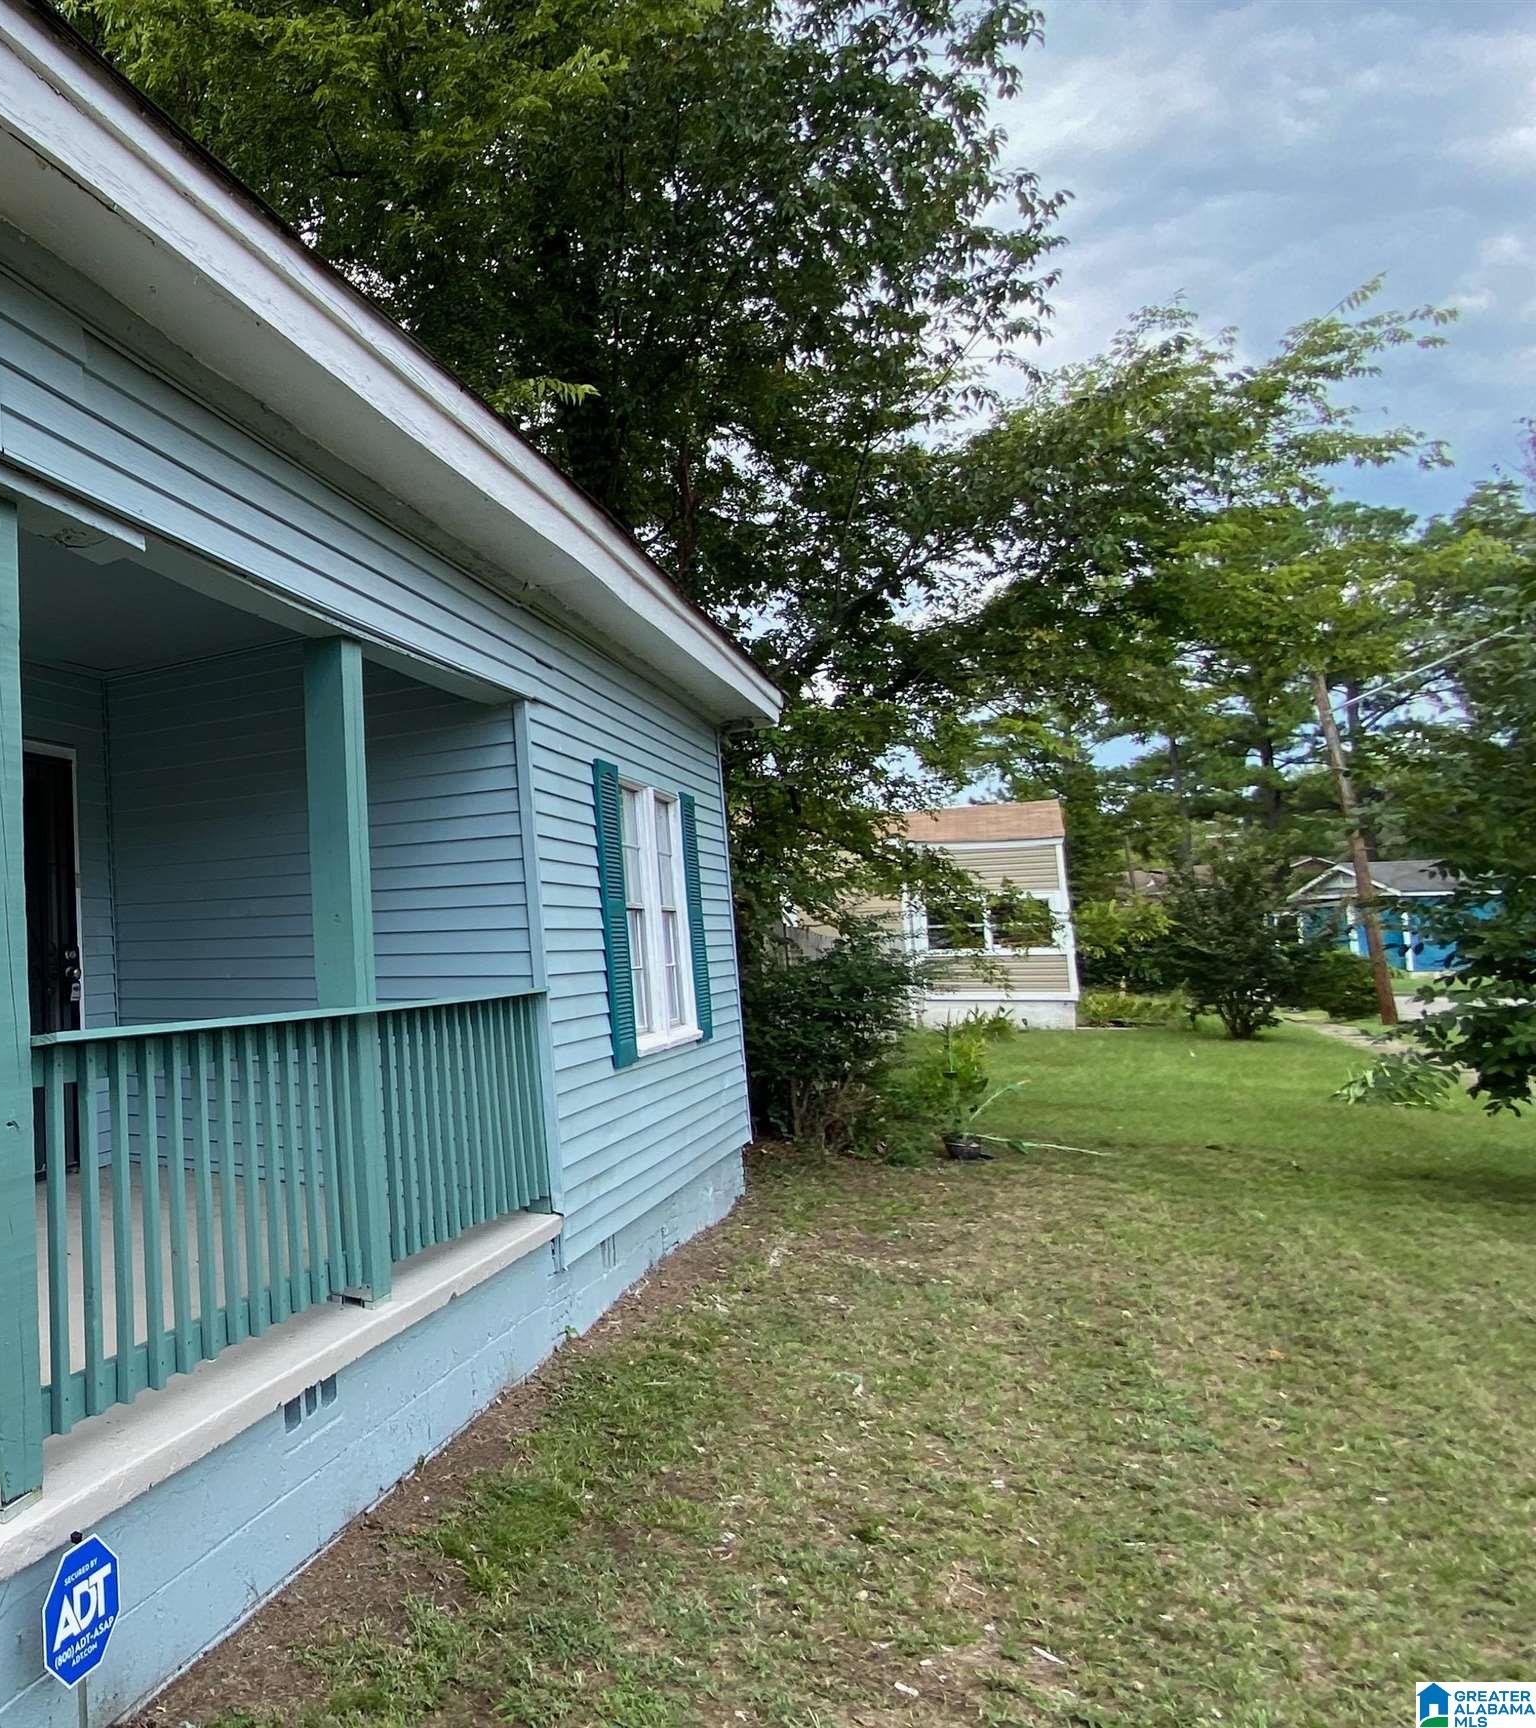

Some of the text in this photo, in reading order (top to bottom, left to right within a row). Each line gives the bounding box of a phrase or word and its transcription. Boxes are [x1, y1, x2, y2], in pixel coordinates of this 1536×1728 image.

[63, 1558, 98, 1586] SECURED BY
[53, 1562, 112, 1653] ADT
[54, 1615, 114, 1670] (800) ADT-ASAP
